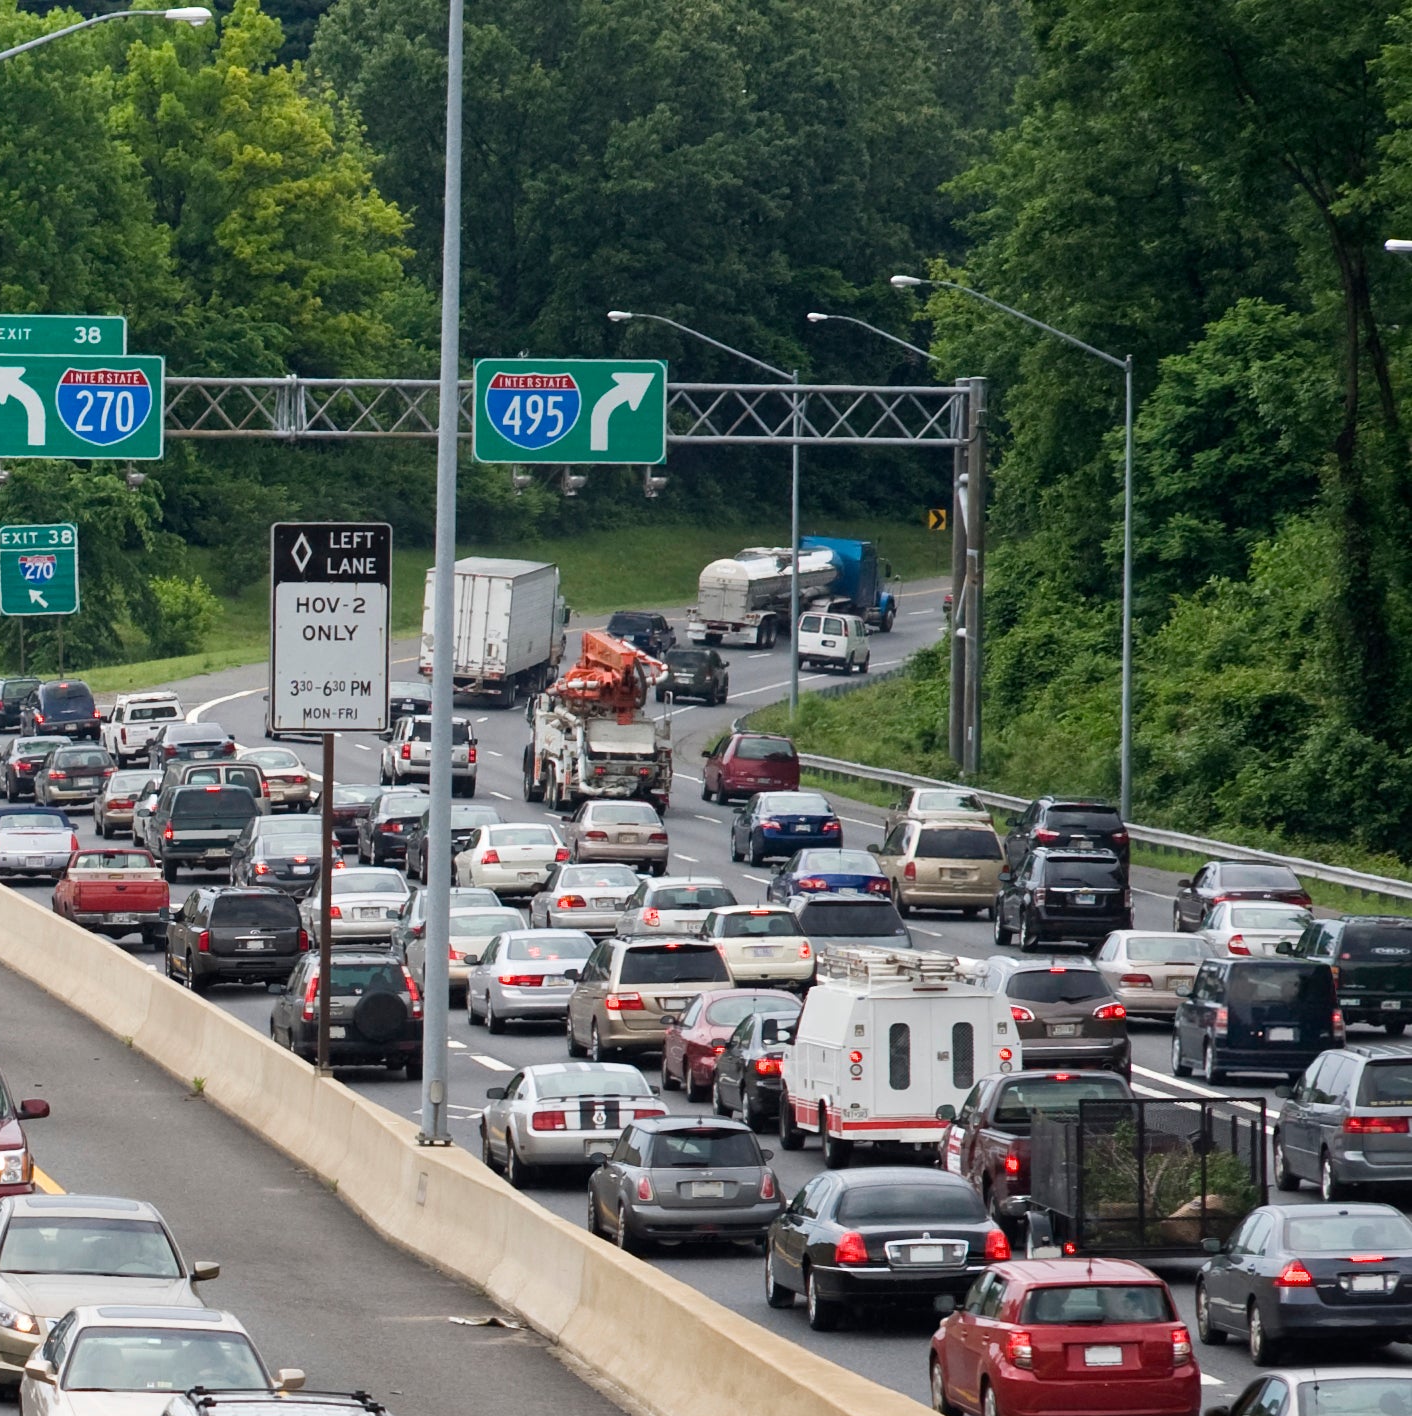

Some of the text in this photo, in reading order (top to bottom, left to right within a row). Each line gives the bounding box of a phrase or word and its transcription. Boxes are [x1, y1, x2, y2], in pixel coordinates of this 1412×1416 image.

[73, 326, 101, 344] 38
[70, 372, 140, 384] INTERSTATE
[499, 377, 568, 388] INTERSTATE
[75, 390, 134, 432] 270
[502, 394, 564, 437] 495
[1, 530, 73, 545] EXIT 38
[329, 531, 374, 548] LEFT
[25, 562, 53, 580] 270
[327, 557, 376, 574] LANE
[296, 597, 366, 614] HOV-2
[302, 625, 359, 641] ONLY
[350, 681, 371, 697] PM
[303, 707, 358, 720] MON-FRI
